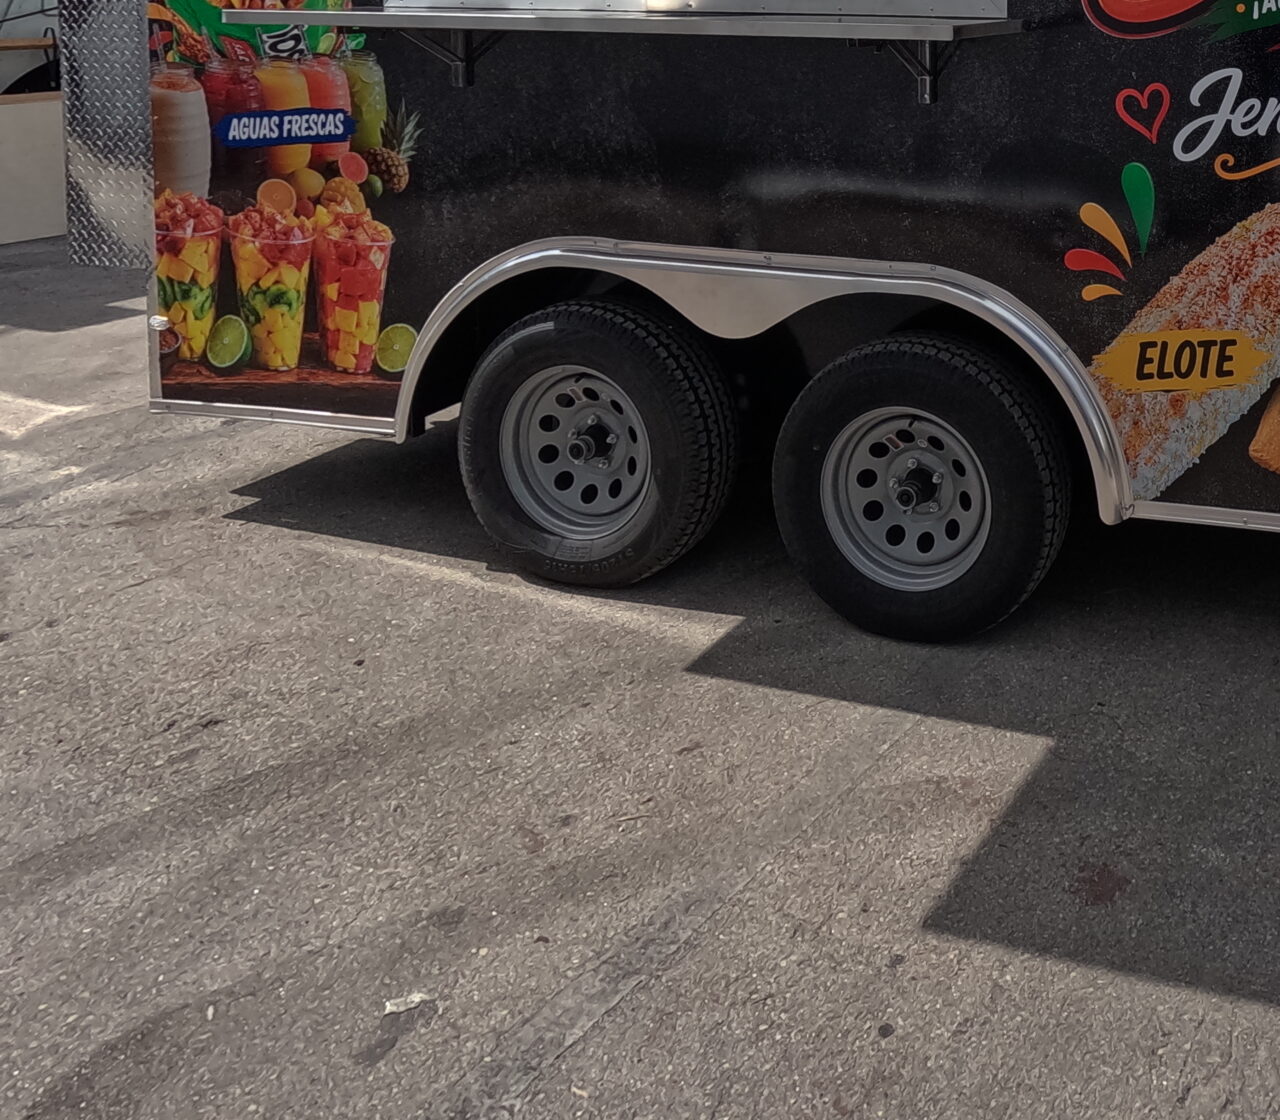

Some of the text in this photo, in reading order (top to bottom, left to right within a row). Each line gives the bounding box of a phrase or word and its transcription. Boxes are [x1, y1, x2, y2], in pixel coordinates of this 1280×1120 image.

[228, 112, 345, 141] AGUAS FRESCAS
[1136, 338, 1238, 381] ELOTE
